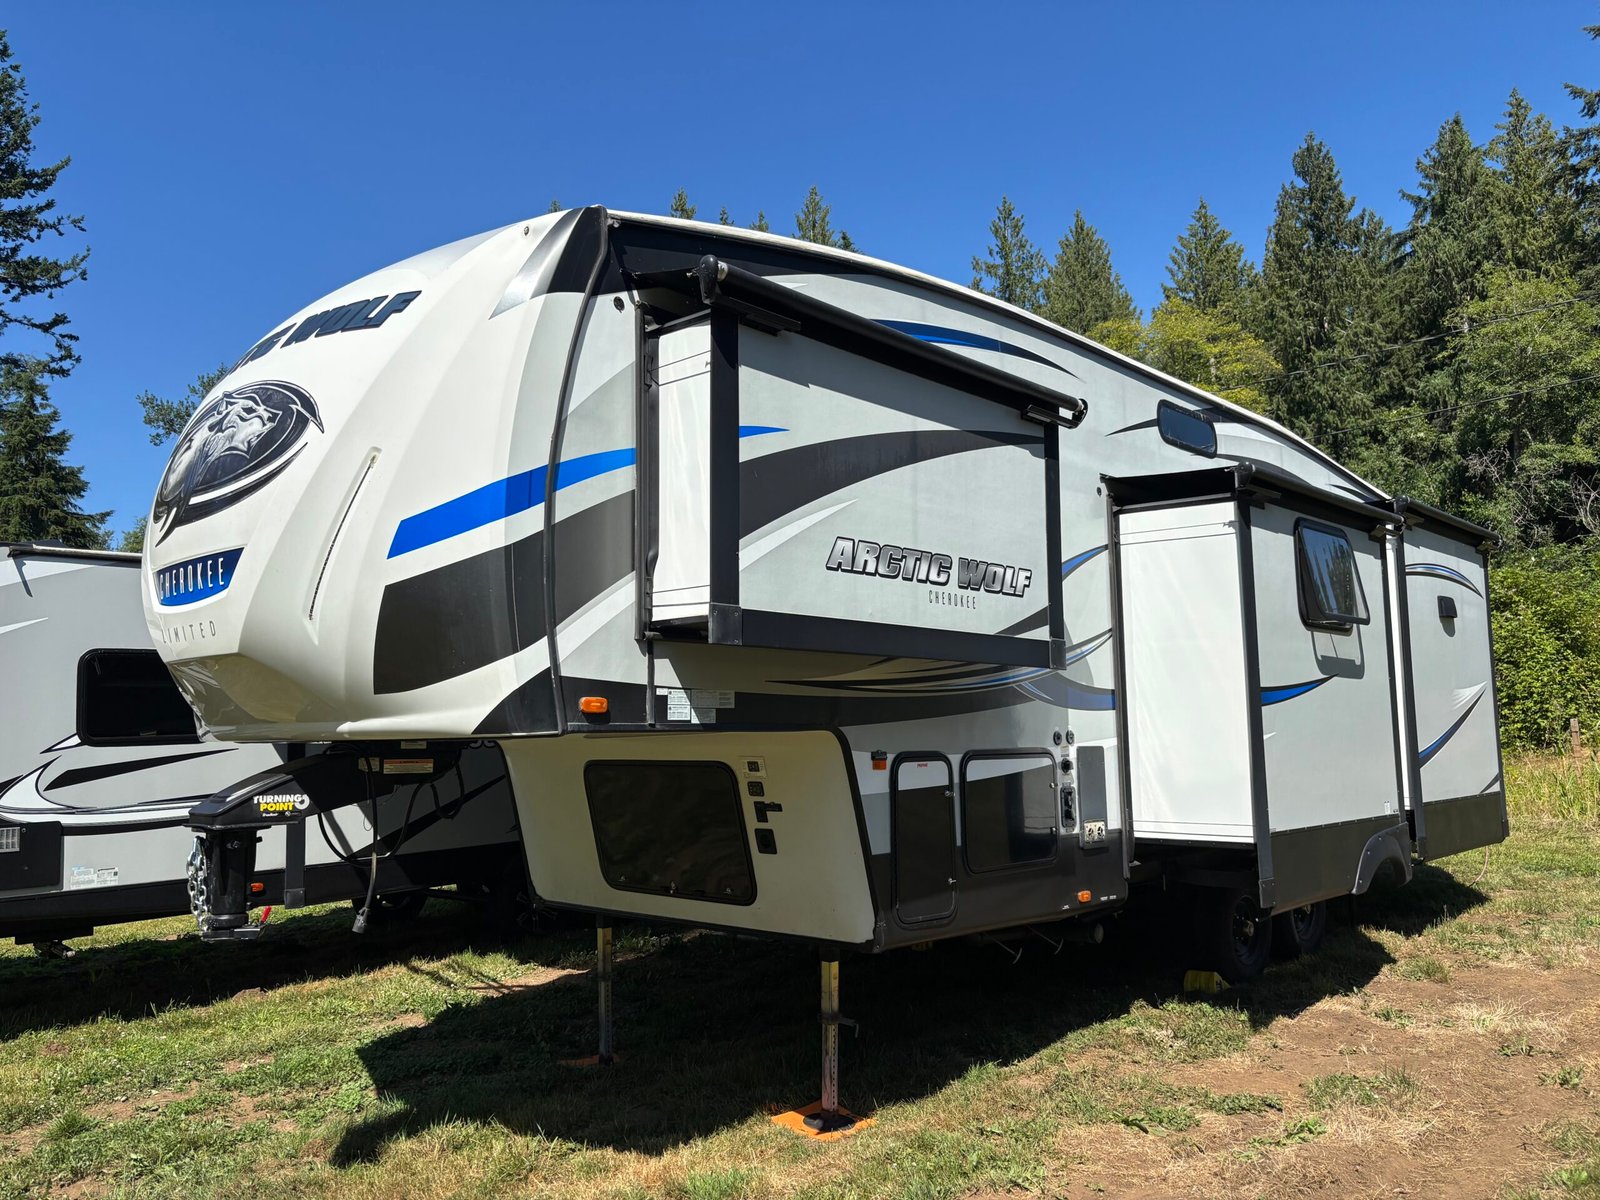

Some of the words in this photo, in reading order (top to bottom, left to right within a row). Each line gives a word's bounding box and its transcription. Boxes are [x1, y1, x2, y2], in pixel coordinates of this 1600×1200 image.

[825, 536, 953, 587] ARCTIC
[957, 557, 1033, 598] WOLF
[160, 557, 225, 600] CHEROKEE
[928, 590, 977, 610] CHEROKEE
[161, 620, 216, 644] LIMITED
[253, 794, 302, 804] TURNING
[260, 802, 295, 811] POINT
